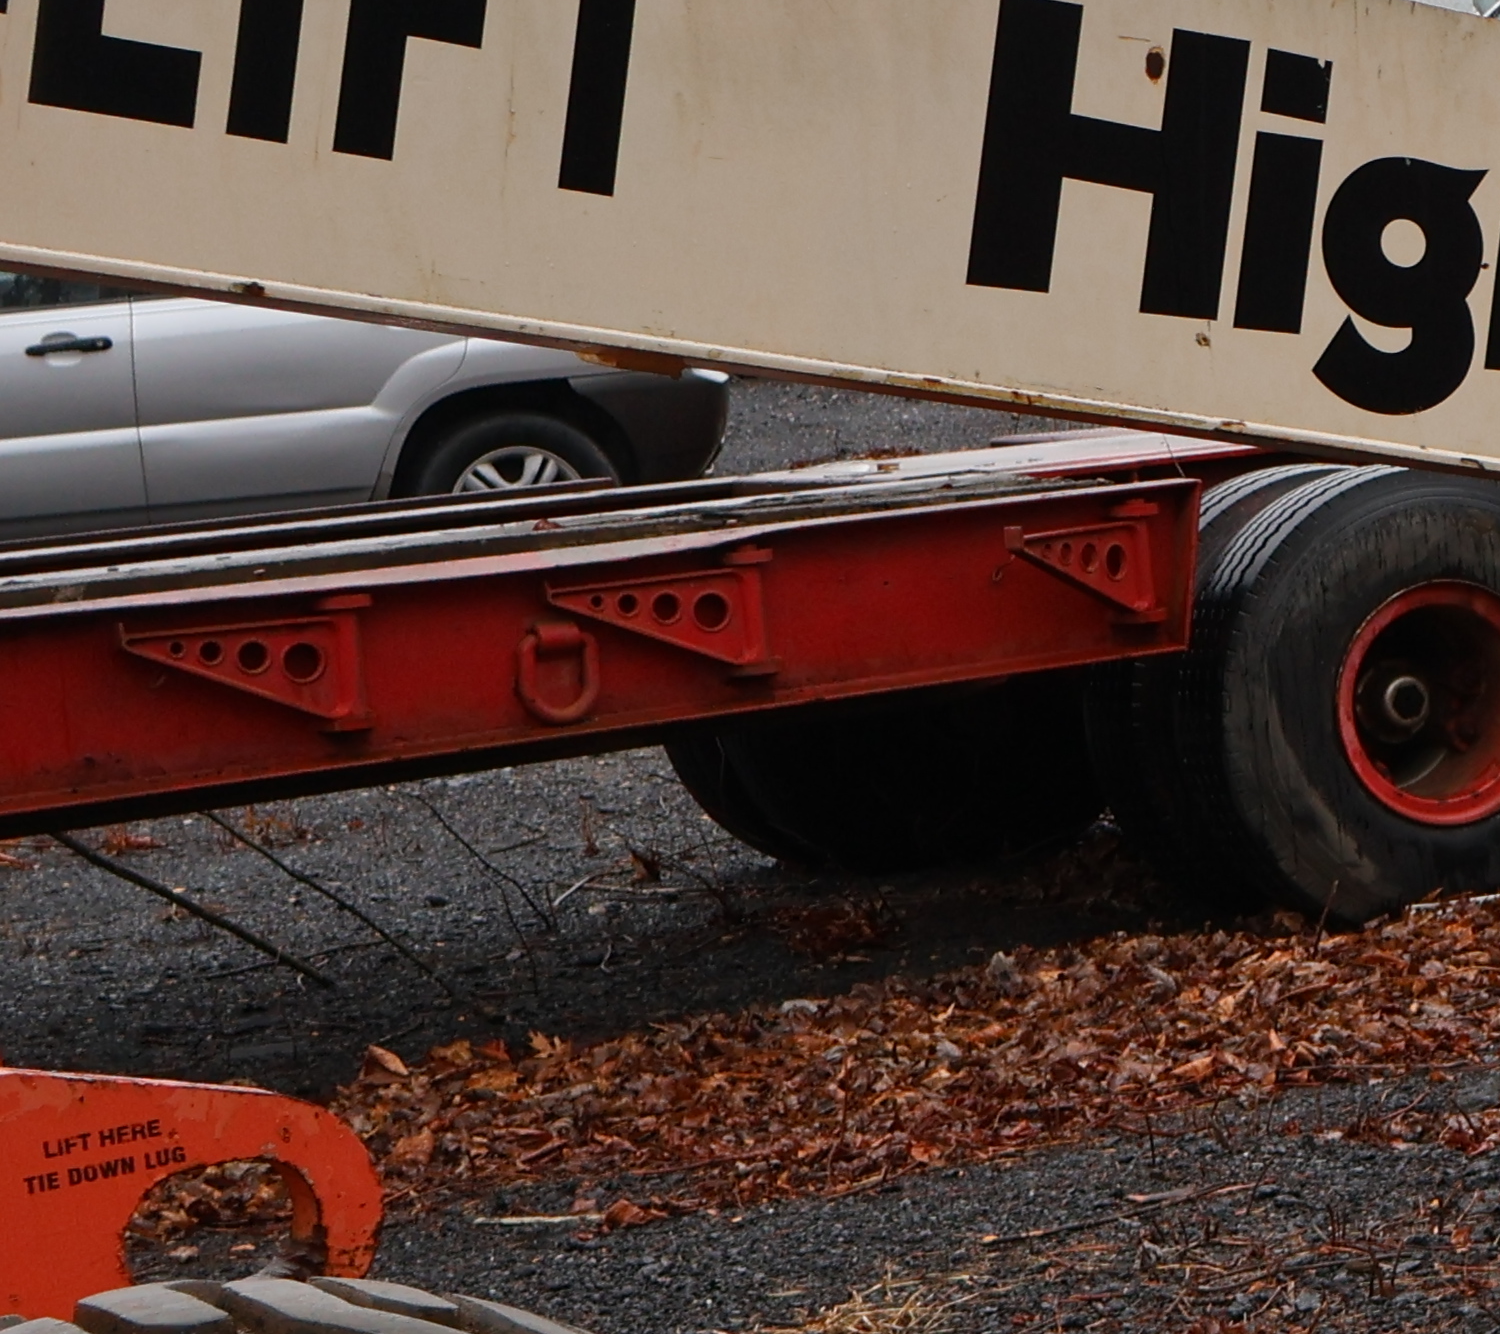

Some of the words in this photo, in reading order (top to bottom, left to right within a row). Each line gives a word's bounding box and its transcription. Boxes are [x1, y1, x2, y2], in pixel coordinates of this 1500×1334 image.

[42, 1133, 91, 1159] LIFT
[98, 1119, 162, 1147] HERE
[23, 1172, 60, 1194] TIE
[67, 1156, 135, 1186] DOWN
[144, 1147, 186, 1169] LUG
